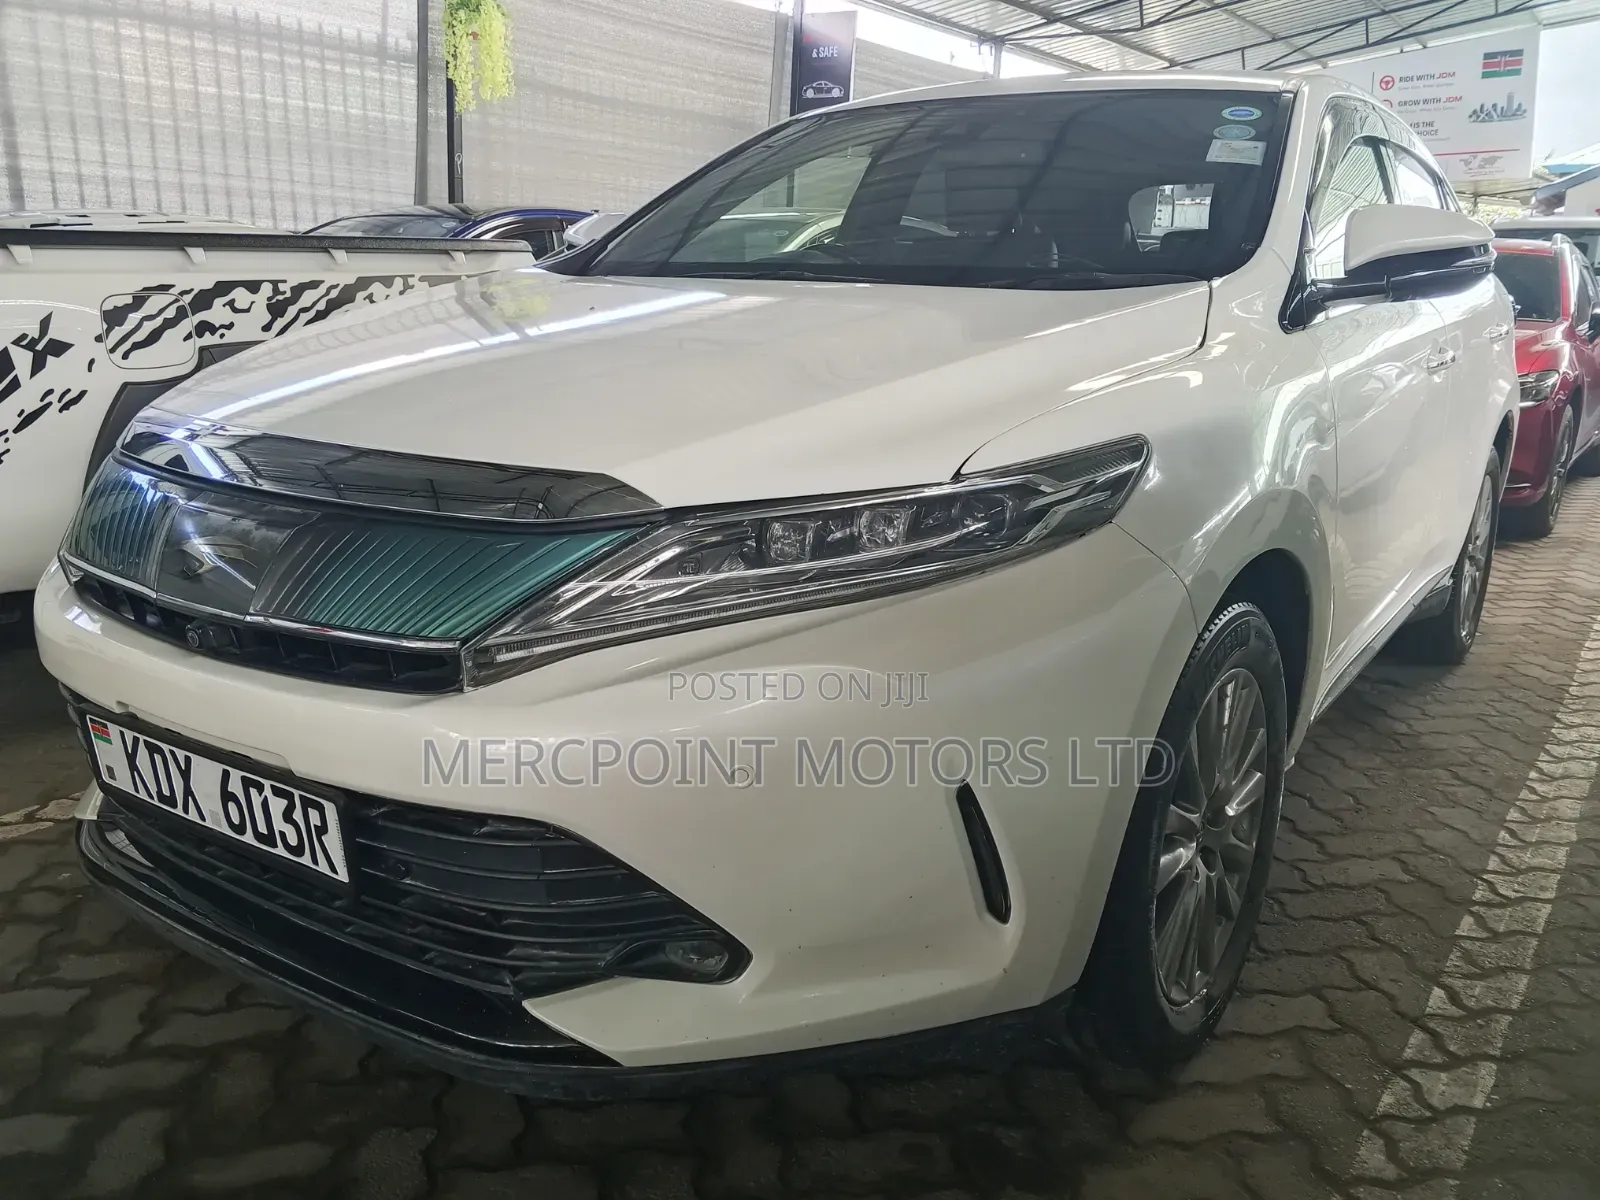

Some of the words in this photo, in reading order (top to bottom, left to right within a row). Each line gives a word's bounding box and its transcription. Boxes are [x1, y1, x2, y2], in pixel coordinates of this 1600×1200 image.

[812, 48, 818, 58] &
[819, 47, 838, 57] SAFE
[1416, 73, 1435, 81] WITH
[1398, 99, 1420, 107] GROW
[1422, 97, 1442, 105] WITH
[1443, 96, 1463, 104] JDM
[1422, 120, 1435, 128] THE
[1415, 129, 1439, 137] HOICE
[118, 729, 207, 823] KDX
[220, 768, 340, 876] 603R
